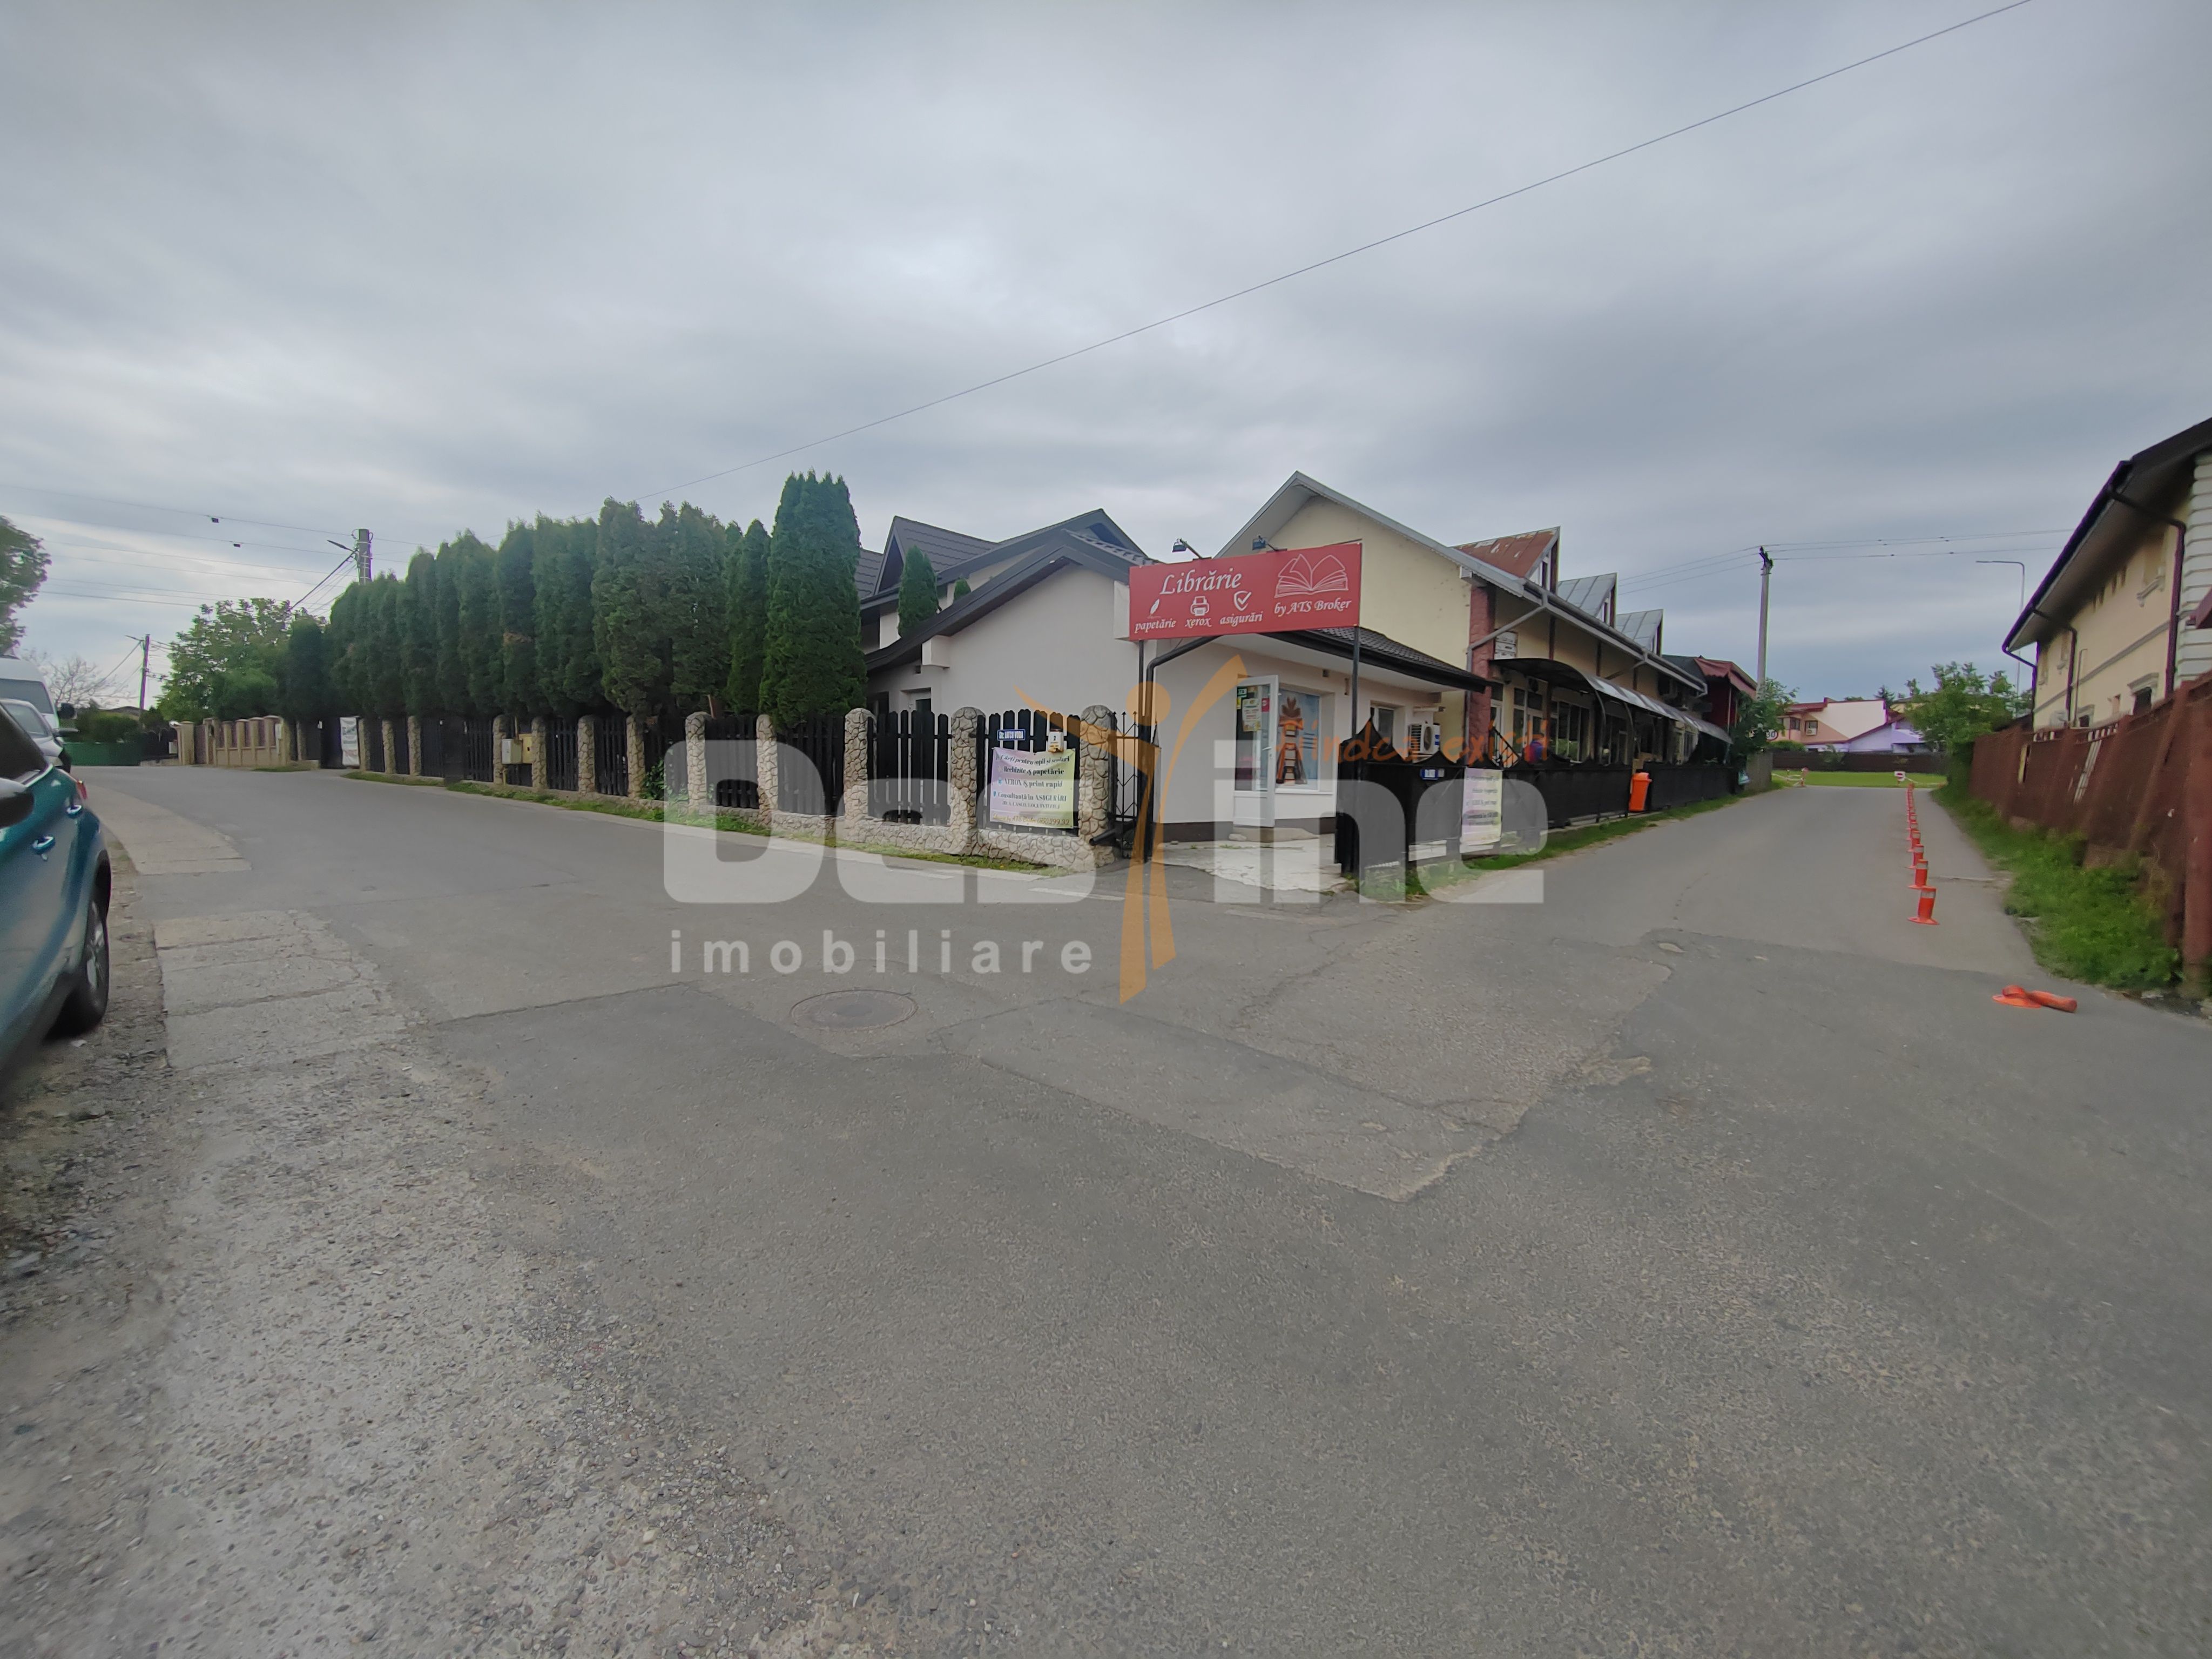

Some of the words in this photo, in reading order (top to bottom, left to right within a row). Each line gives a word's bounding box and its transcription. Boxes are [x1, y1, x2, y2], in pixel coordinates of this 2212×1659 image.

[1159, 567, 1243, 595] Librărie
[1273, 602, 1286, 617] by
[1286, 600, 1313, 615] ATS
[1314, 597, 1352, 612] Broker
[1134, 618, 1177, 634] papetărie
[1185, 617, 1212, 629] xerox
[1219, 611, 1264, 628] asigurări
[1029, 780, 1044, 788] print
[1046, 780, 1063, 790] rapid
